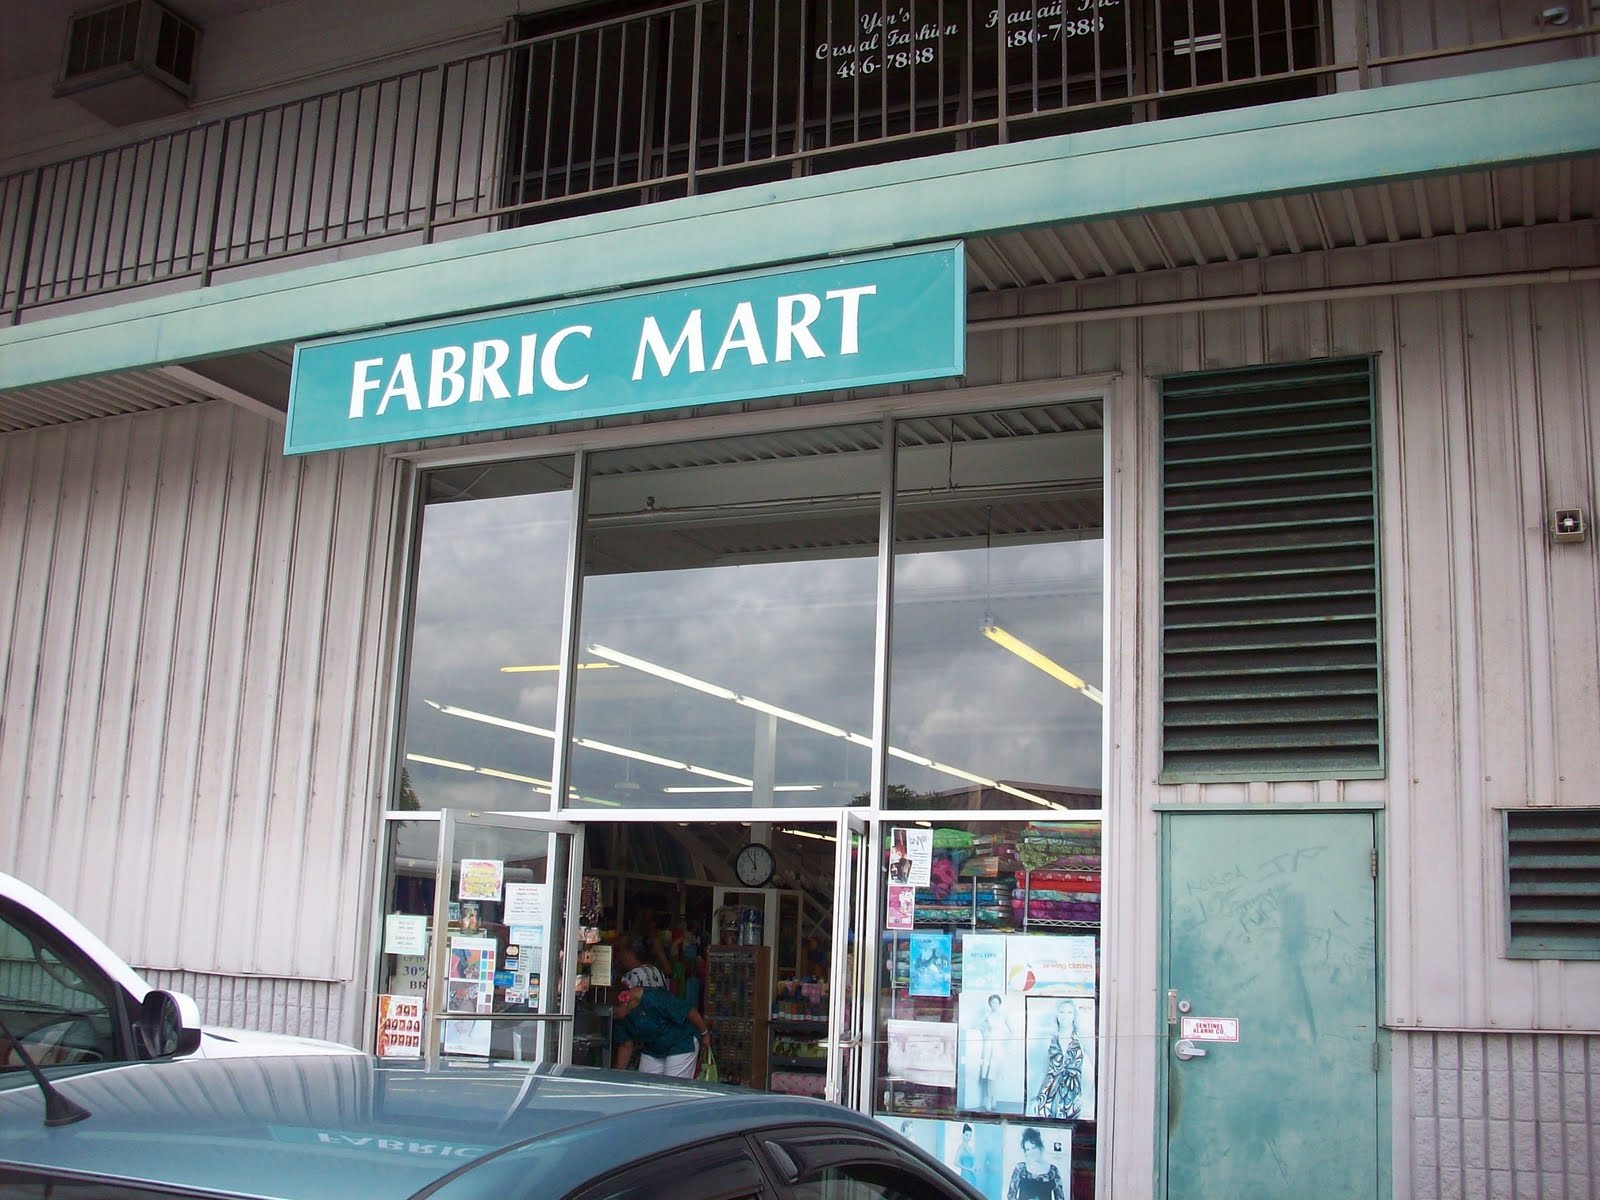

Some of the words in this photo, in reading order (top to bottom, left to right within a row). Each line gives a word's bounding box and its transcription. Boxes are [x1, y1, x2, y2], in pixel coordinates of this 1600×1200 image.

[860, 7, 910, 35] Yen's
[349, 325, 592, 419] FABRIC
[631, 285, 877, 381] MART
[1042, 962, 1067, 970] sewing
